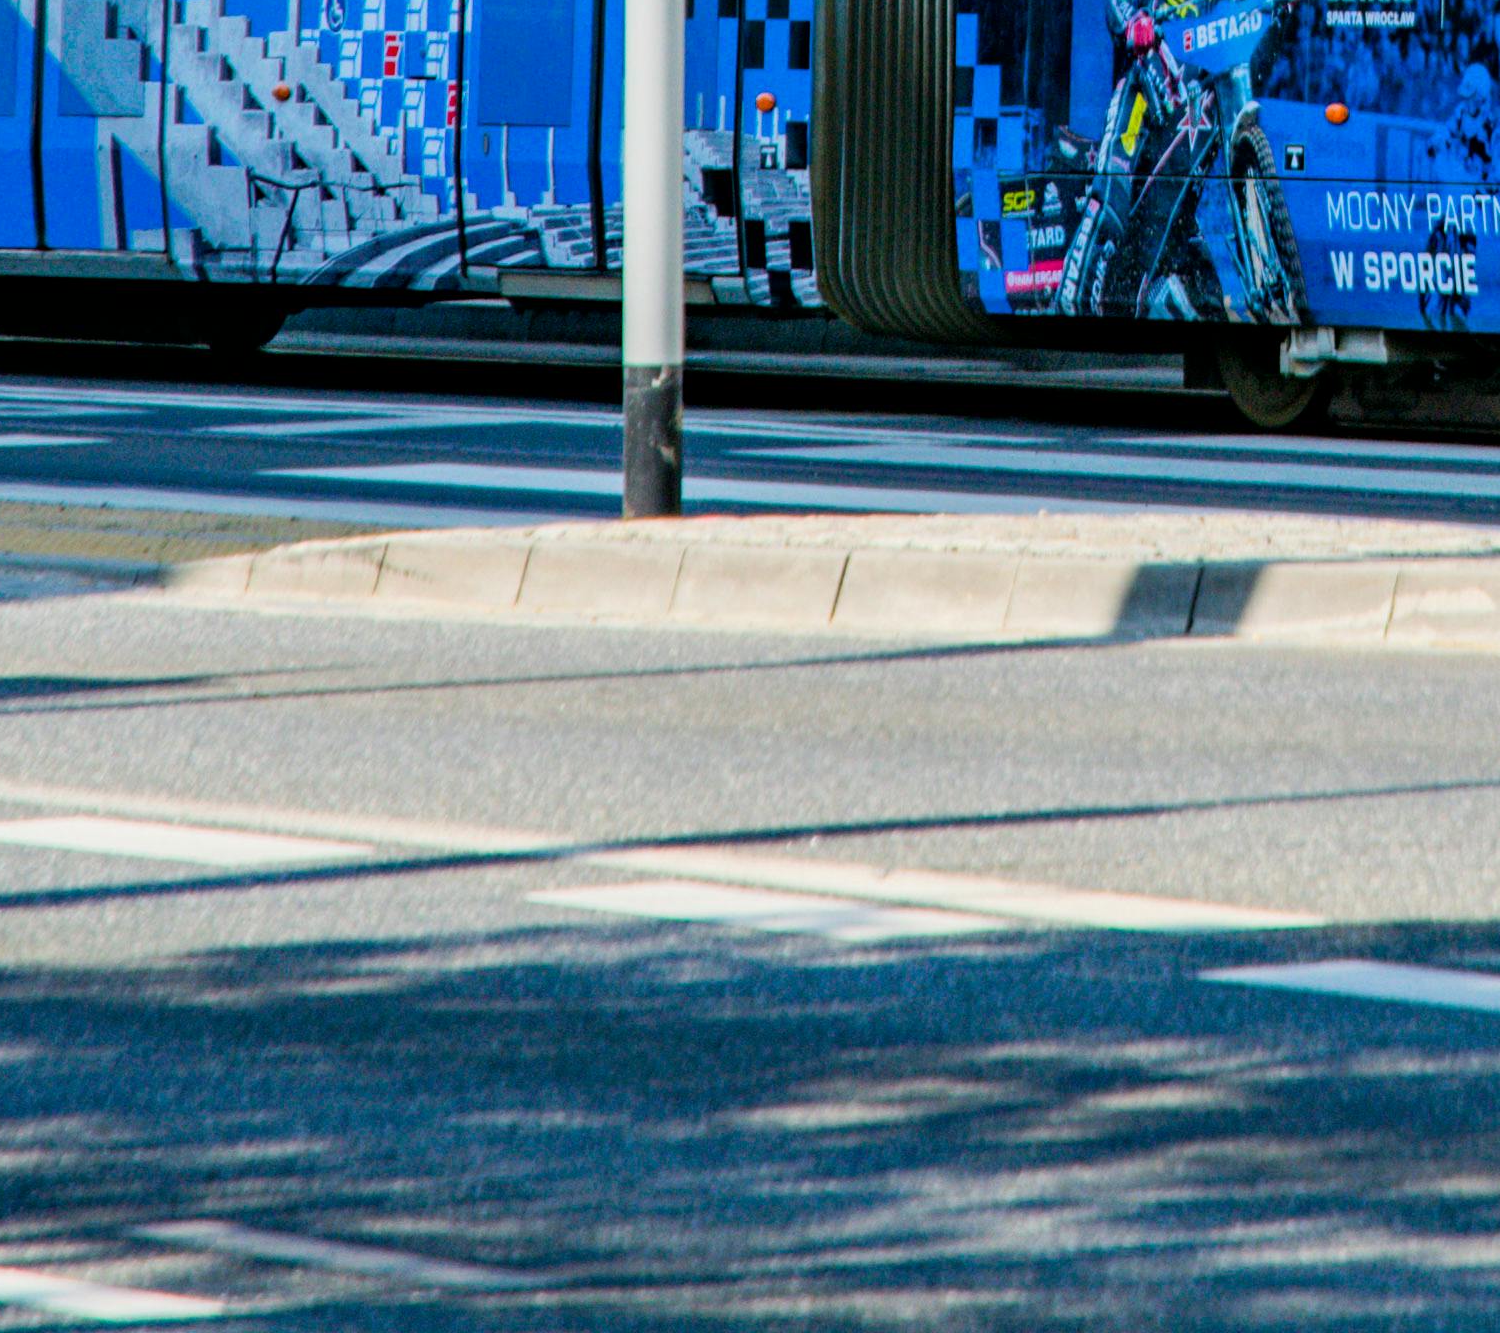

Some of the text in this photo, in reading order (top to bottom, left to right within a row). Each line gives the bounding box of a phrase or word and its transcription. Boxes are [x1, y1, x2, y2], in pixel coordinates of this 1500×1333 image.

[1196, 9, 1263, 49] BETARD
[1326, 10, 1415, 27] SPARTA WROCŁAW
[1003, 190, 1036, 212] SGP
[1326, 191, 1416, 231] MOCNY
[1330, 250, 1479, 294] W SPORCIE
